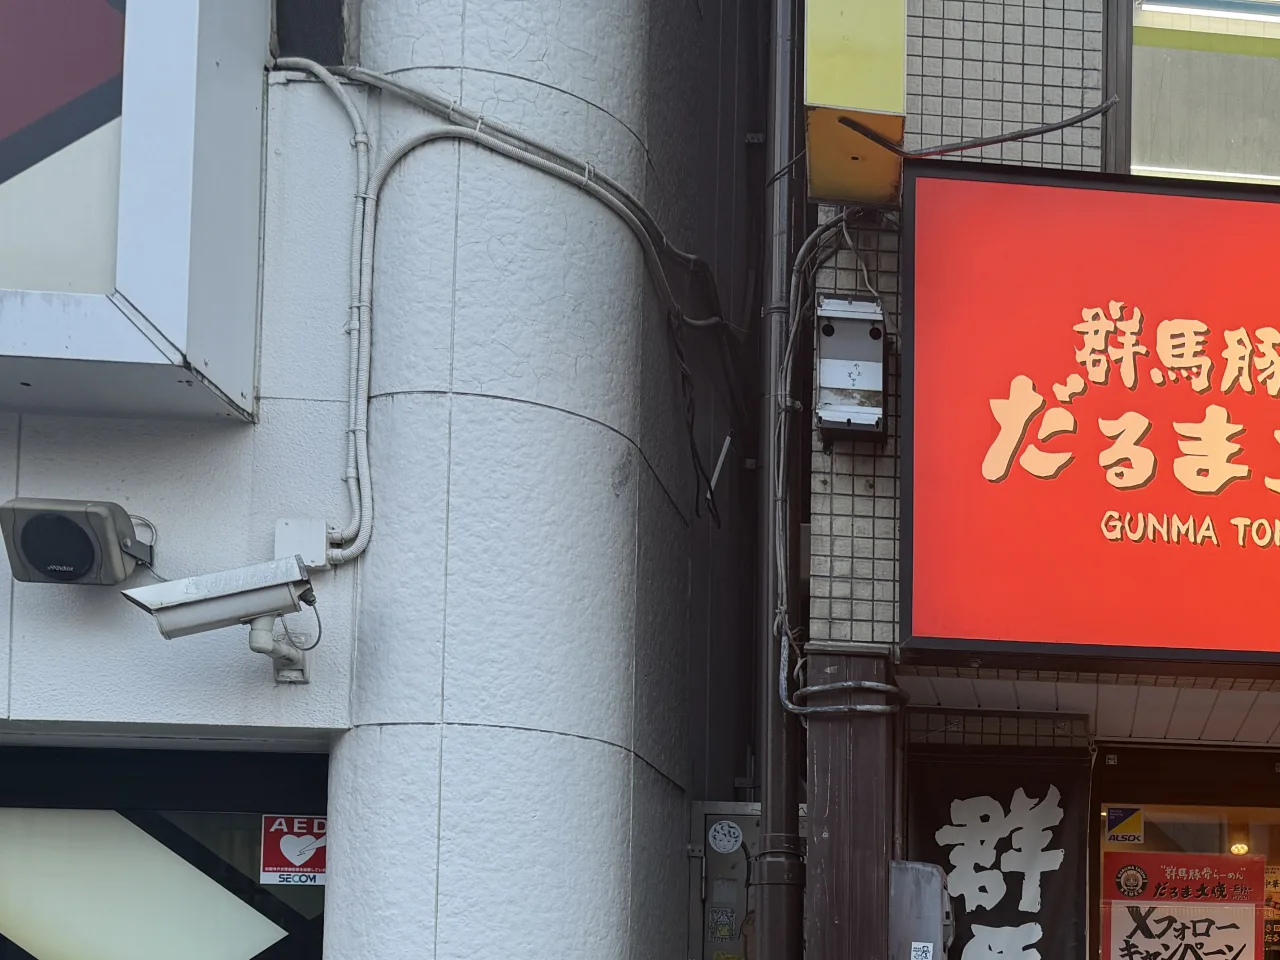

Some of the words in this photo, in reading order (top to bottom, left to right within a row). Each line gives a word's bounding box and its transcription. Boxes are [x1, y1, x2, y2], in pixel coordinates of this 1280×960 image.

[1099, 510, 1219, 548] GUNMA
[269, 817, 327, 834] AED
[1108, 834, 1142, 842] ALSOK
[278, 873, 317, 884] SECOM
[1125, 905, 1241, 942] Xフォロー
